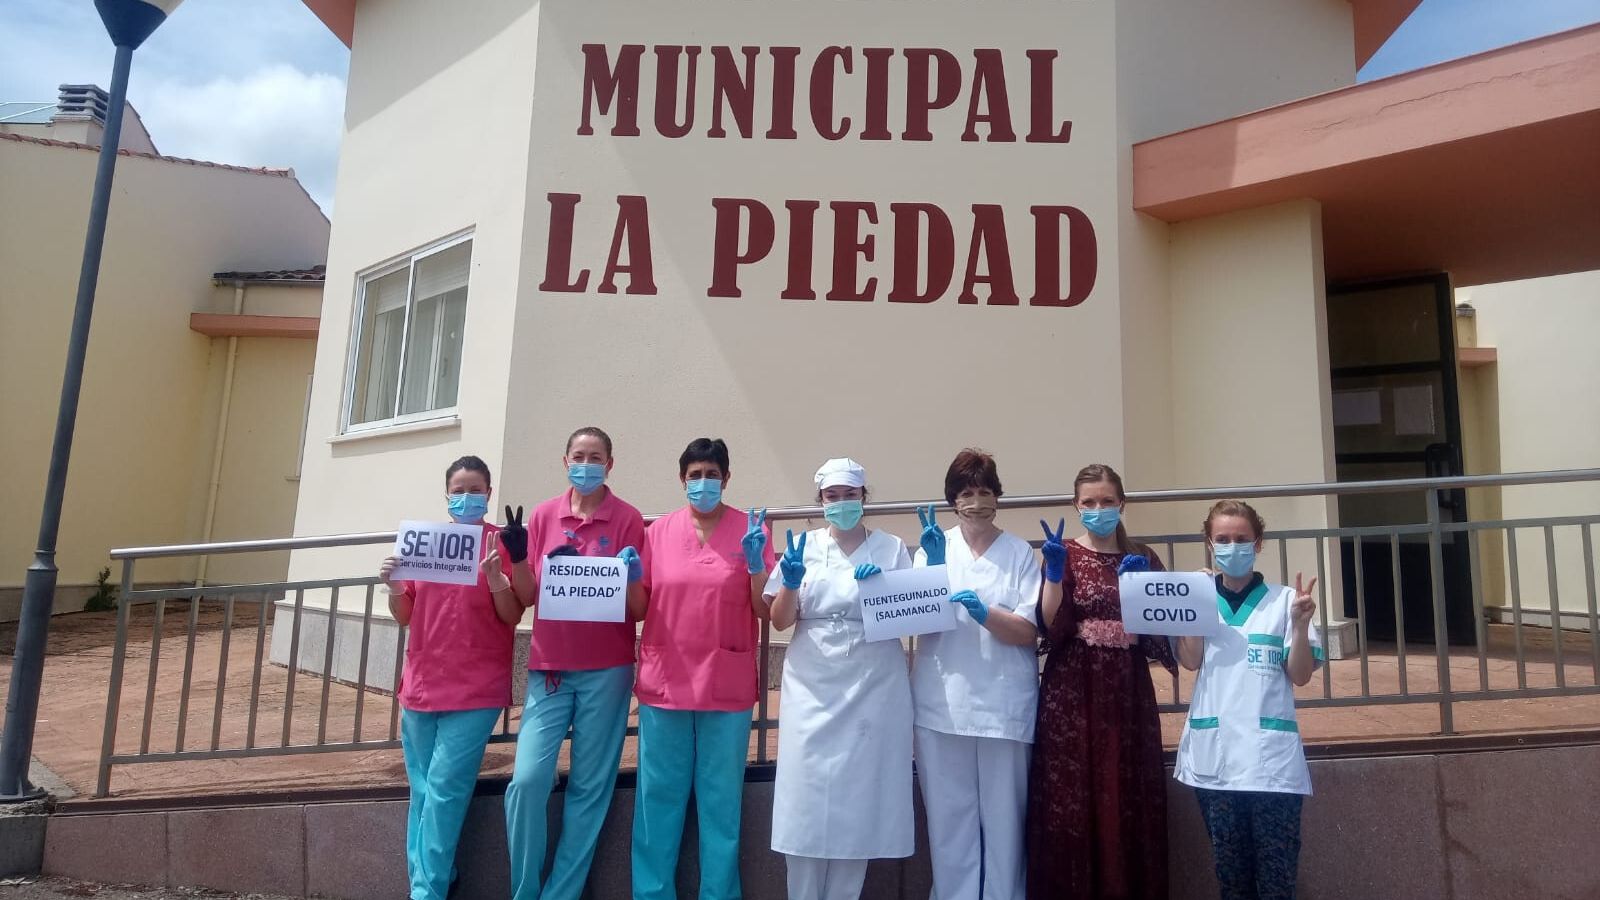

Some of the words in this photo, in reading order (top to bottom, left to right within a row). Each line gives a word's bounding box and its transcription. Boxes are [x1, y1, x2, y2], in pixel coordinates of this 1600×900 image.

[577, 43, 1073, 143] MUNICIPAL
[538, 192, 658, 296] LA
[707, 197, 1098, 307] PIEDAD
[400, 530, 475, 560] SENIOR
[399, 558, 433, 570] Servicios
[434, 561, 472, 573] Integrales
[549, 565, 620, 577] RESIDENCIA
[863, 587, 948, 607] FUENTEGUINALDO
[1144, 583, 1190, 597] CERO
[875, 602, 941, 622] (SALAMANCA)
[1142, 608, 1197, 622] COVID
